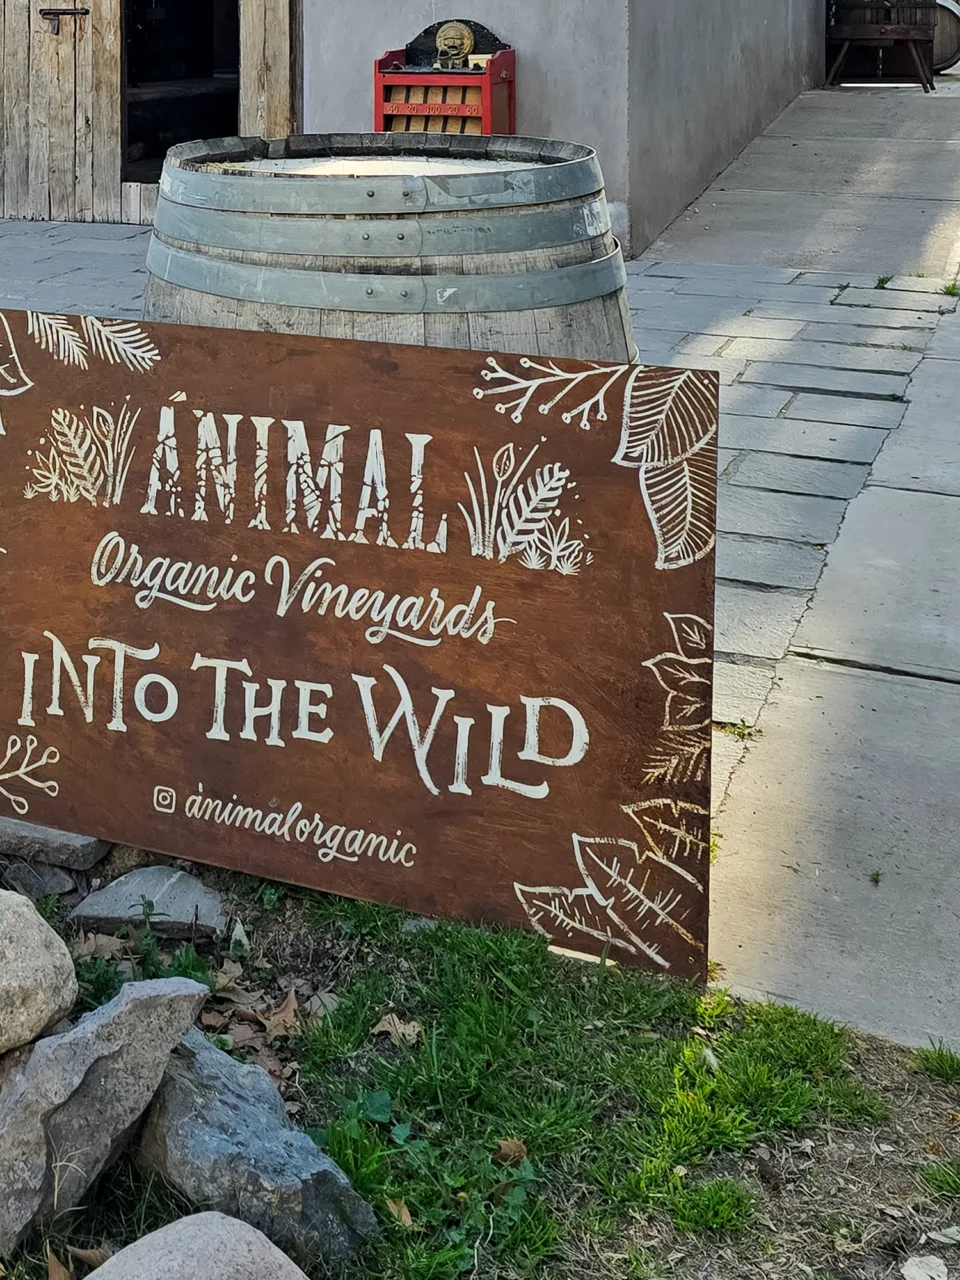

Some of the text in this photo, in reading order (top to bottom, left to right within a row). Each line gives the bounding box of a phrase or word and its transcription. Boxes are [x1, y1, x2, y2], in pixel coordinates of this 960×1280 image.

[387, 104, 479, 116] 60 20 100 20 60
[90, 530, 518, 648] Organic Vineyards
[191, 652, 335, 748] THE
[351, 663, 590, 799] WILD
